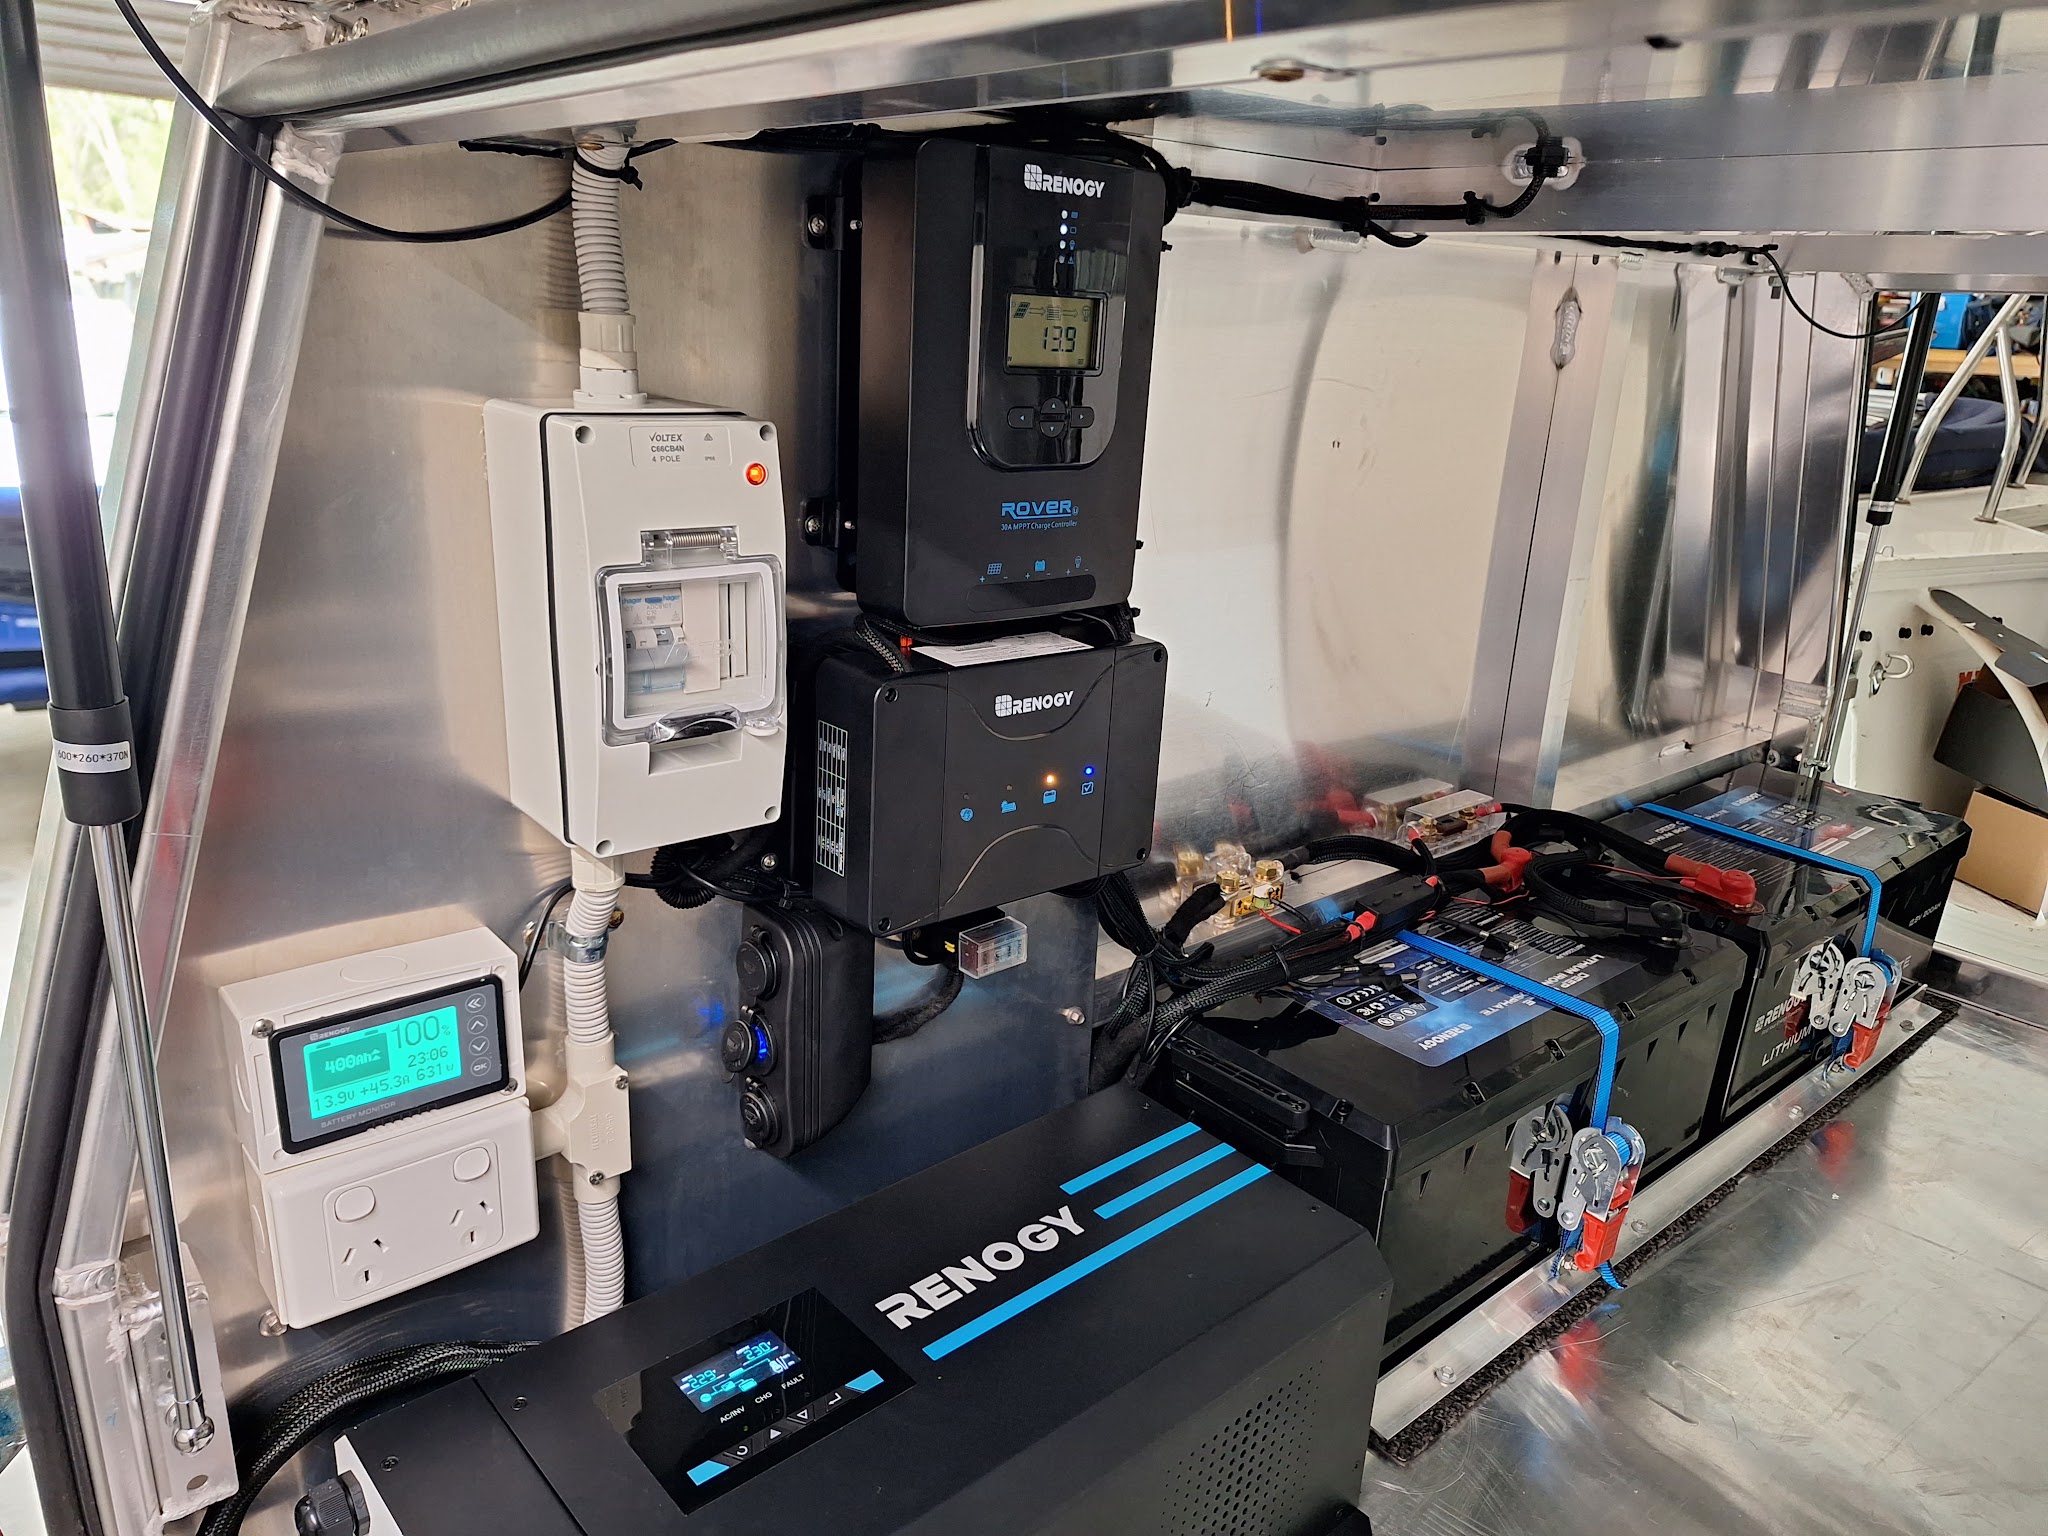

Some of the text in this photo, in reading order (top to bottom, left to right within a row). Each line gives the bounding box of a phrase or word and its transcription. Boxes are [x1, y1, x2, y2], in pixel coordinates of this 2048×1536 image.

[1042, 173, 1105, 198] RENOGY
[1043, 326, 1077, 352] 13.9
[649, 432, 683, 442] VOLTEX
[660, 455, 681, 463] POLE
[1013, 522, 1030, 530] MPPT
[1030, 521, 1051, 531] Charge
[1051, 519, 1077, 528] Controller
[1012, 690, 1075, 715] RENOGY
[1564, 954, 1605, 975] LITHIUM
[1560, 972, 1590, 989] DEEP
[1764, 996, 1804, 1027] RENO
[318, 1026, 351, 1040] RENOGY
[1418, 1026, 1465, 1051] RENOGY
[408, 1046, 449, 1068] 23:06
[473, 1062, 487, 1071] OK
[321, 1101, 396, 1129] BATTERY MONITOR
[874, 1205, 1085, 1330] RENOGY
[781, 1373, 805, 1390] FAULT
[754, 1391, 773, 1404] CHG
[719, 1405, 745, 1424] AC/INV
